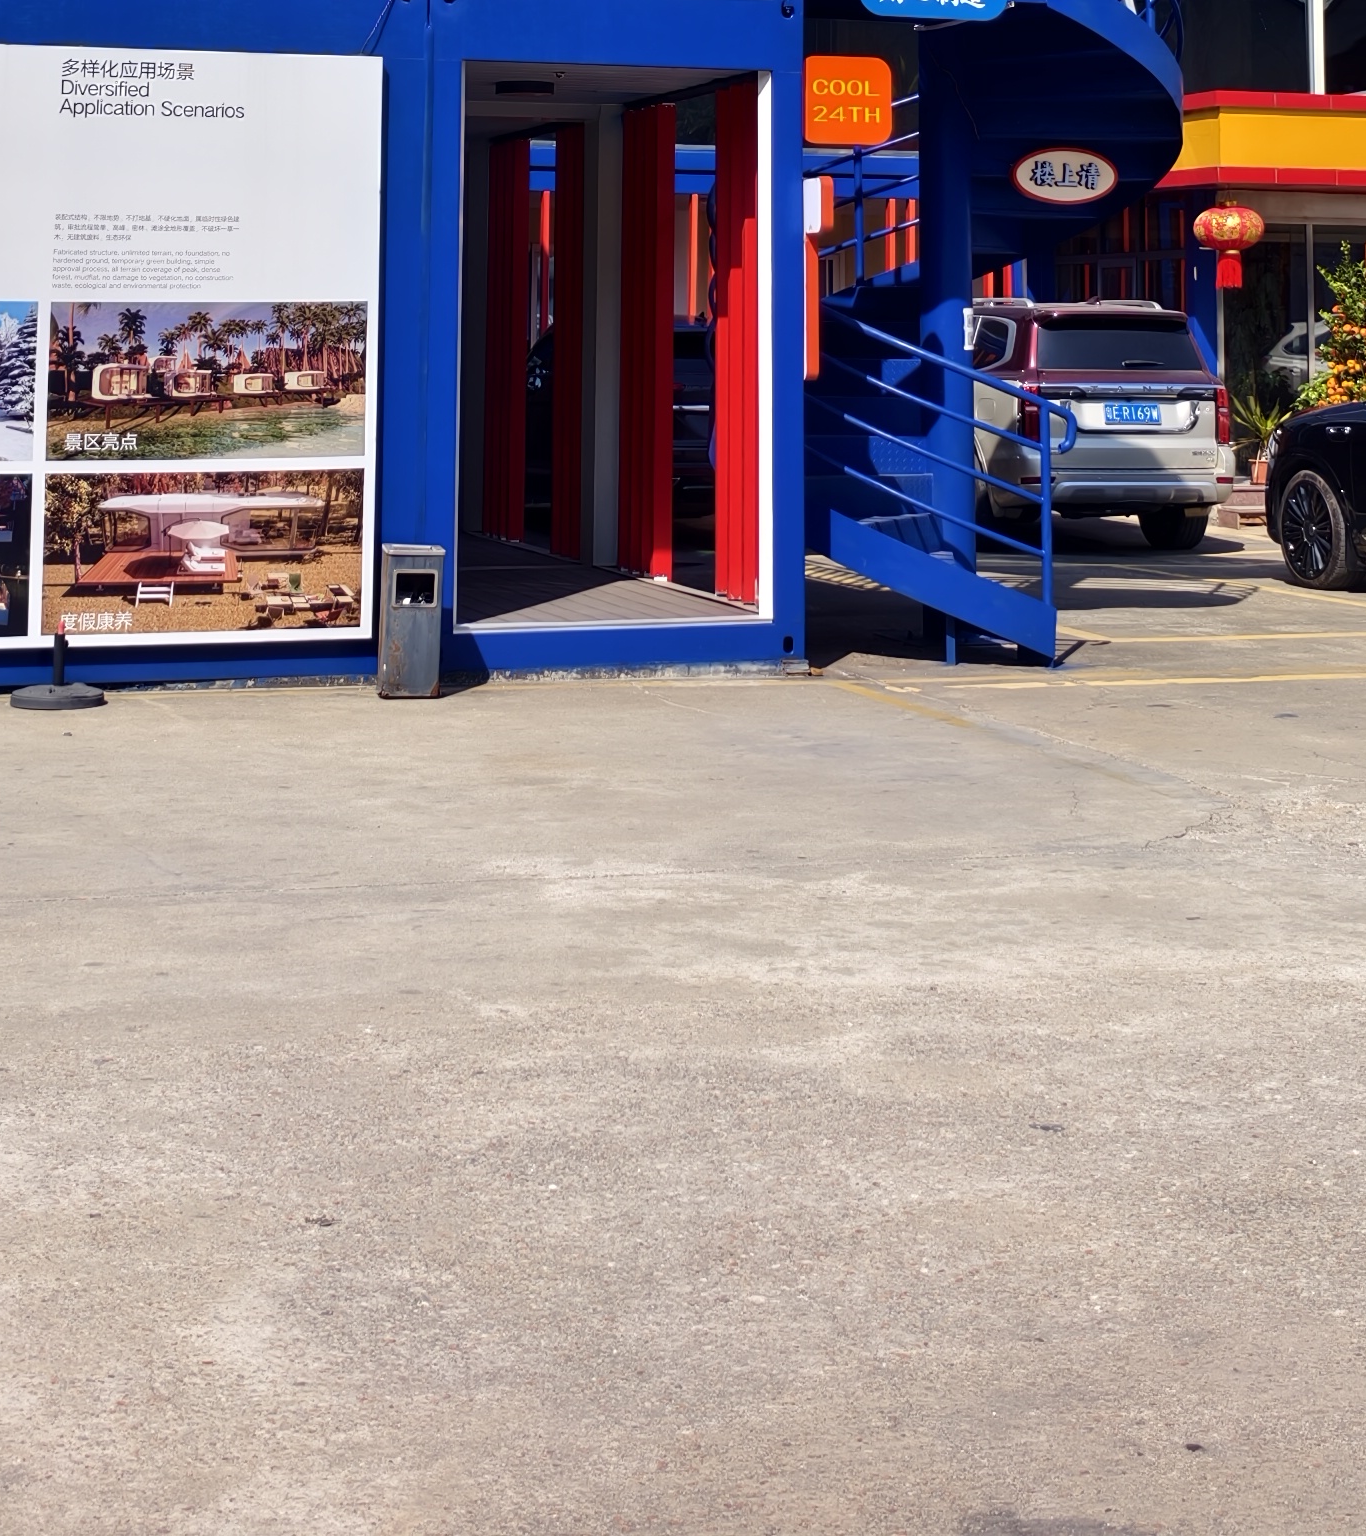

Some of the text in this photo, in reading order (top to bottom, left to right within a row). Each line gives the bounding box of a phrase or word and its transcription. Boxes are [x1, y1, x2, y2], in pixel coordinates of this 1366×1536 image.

[62, 59, 195, 80] 多样化应用场景
[61, 80, 150, 97] Diversified
[812, 79, 880, 97] COOL
[59, 98, 245, 118] Application Scenarios
[813, 105, 881, 123] 24TH
[1090, 385, 1174, 393] TANK
[64, 432, 138, 451] 景区亮点
[60, 612, 133, 631] 度假康养
